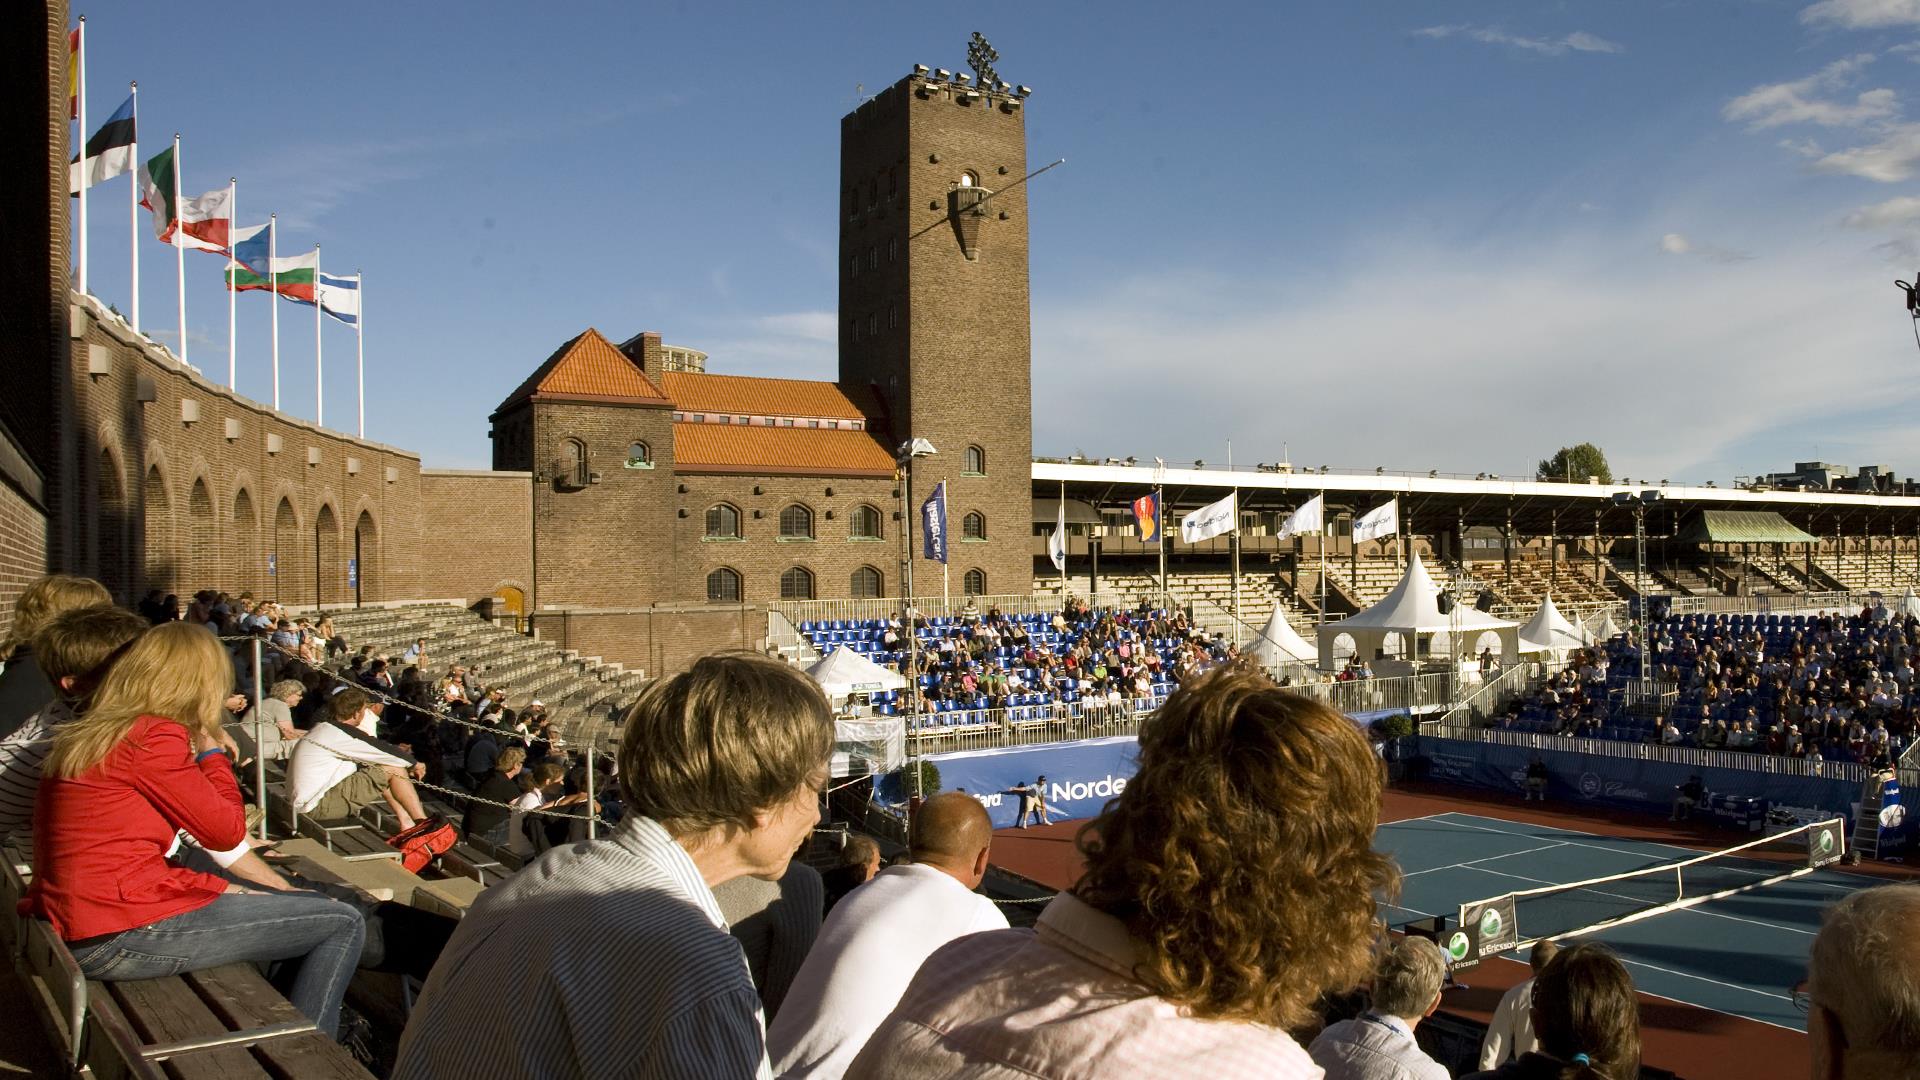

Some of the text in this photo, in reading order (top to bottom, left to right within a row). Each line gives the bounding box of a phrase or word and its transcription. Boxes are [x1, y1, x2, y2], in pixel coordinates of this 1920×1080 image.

[972, 793, 1002, 808] ard
[1486, 942, 1516, 952] Ericsson
[1455, 959, 1479, 969] Ericsson
